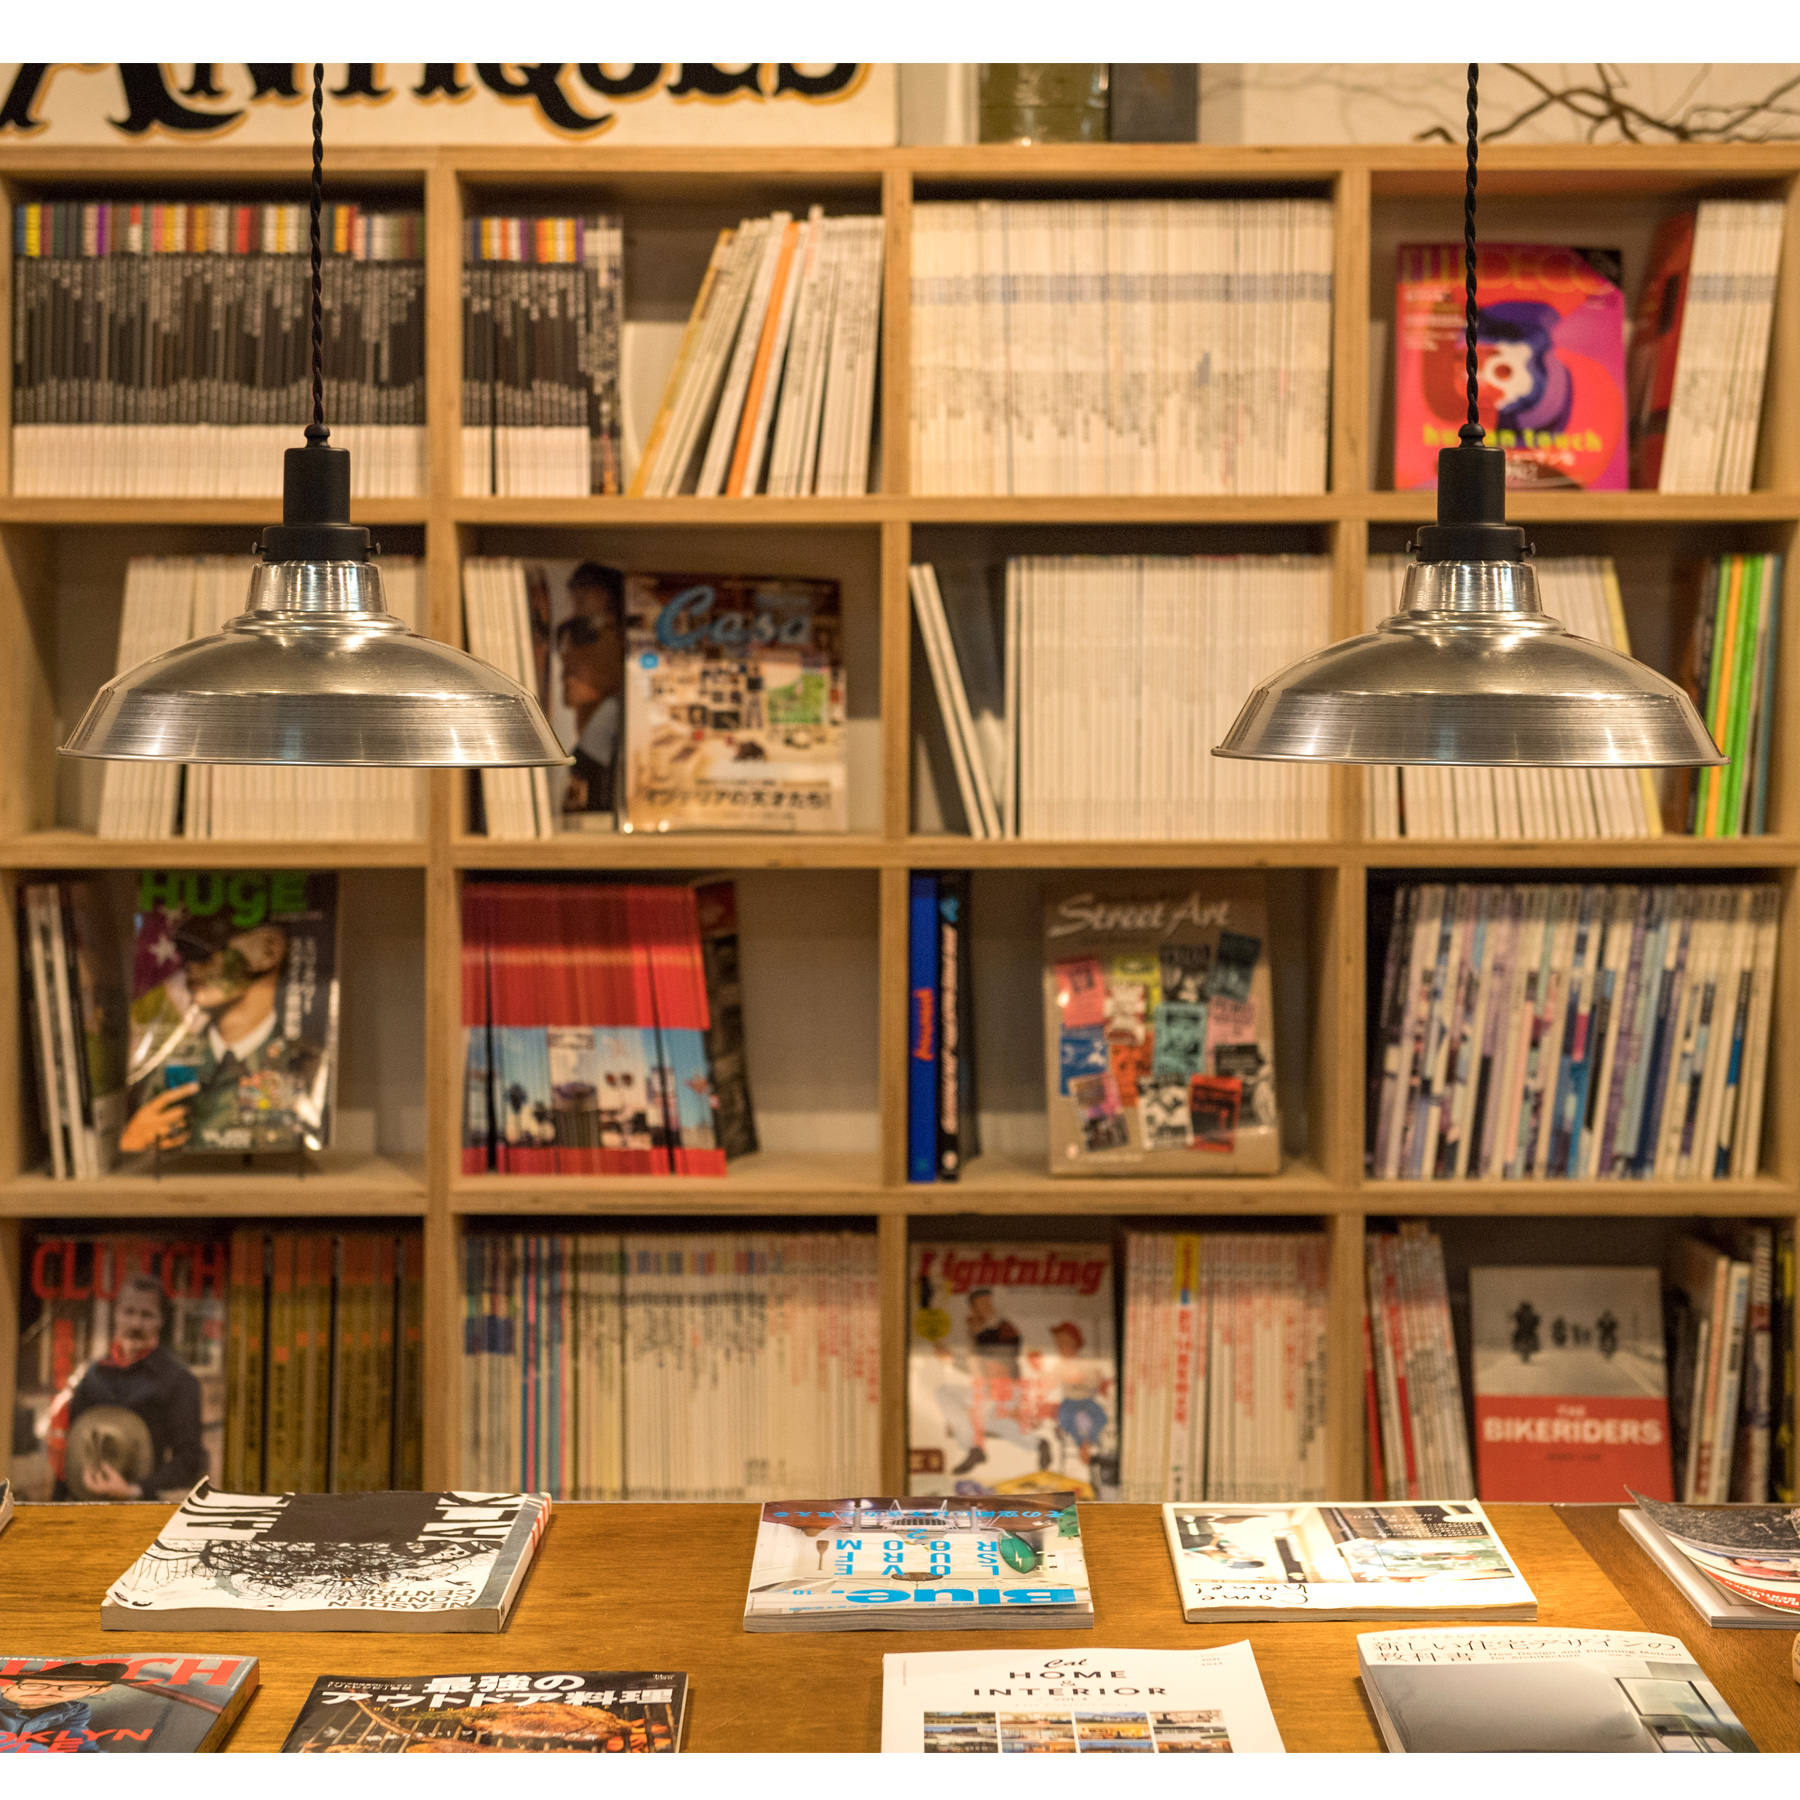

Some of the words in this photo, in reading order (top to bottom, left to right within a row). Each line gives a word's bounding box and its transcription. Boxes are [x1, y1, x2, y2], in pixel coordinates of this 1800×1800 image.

[1423, 424, 1516, 447] huan
[1483, 1417, 1663, 1445] BIKERIDERS
[328, 1601, 470, 1609] NEASDEN
[1375, 1639, 1676, 1652] 新しい住宅デザインの
[1376, 1652, 1476, 1662] 教科書
[1009, 1671, 1127, 1679] HOME
[422, 1674, 585, 1693] 最強の
[321, 1688, 674, 1708] アウトドア料理
[974, 1687, 1168, 1696] INTERIOR
